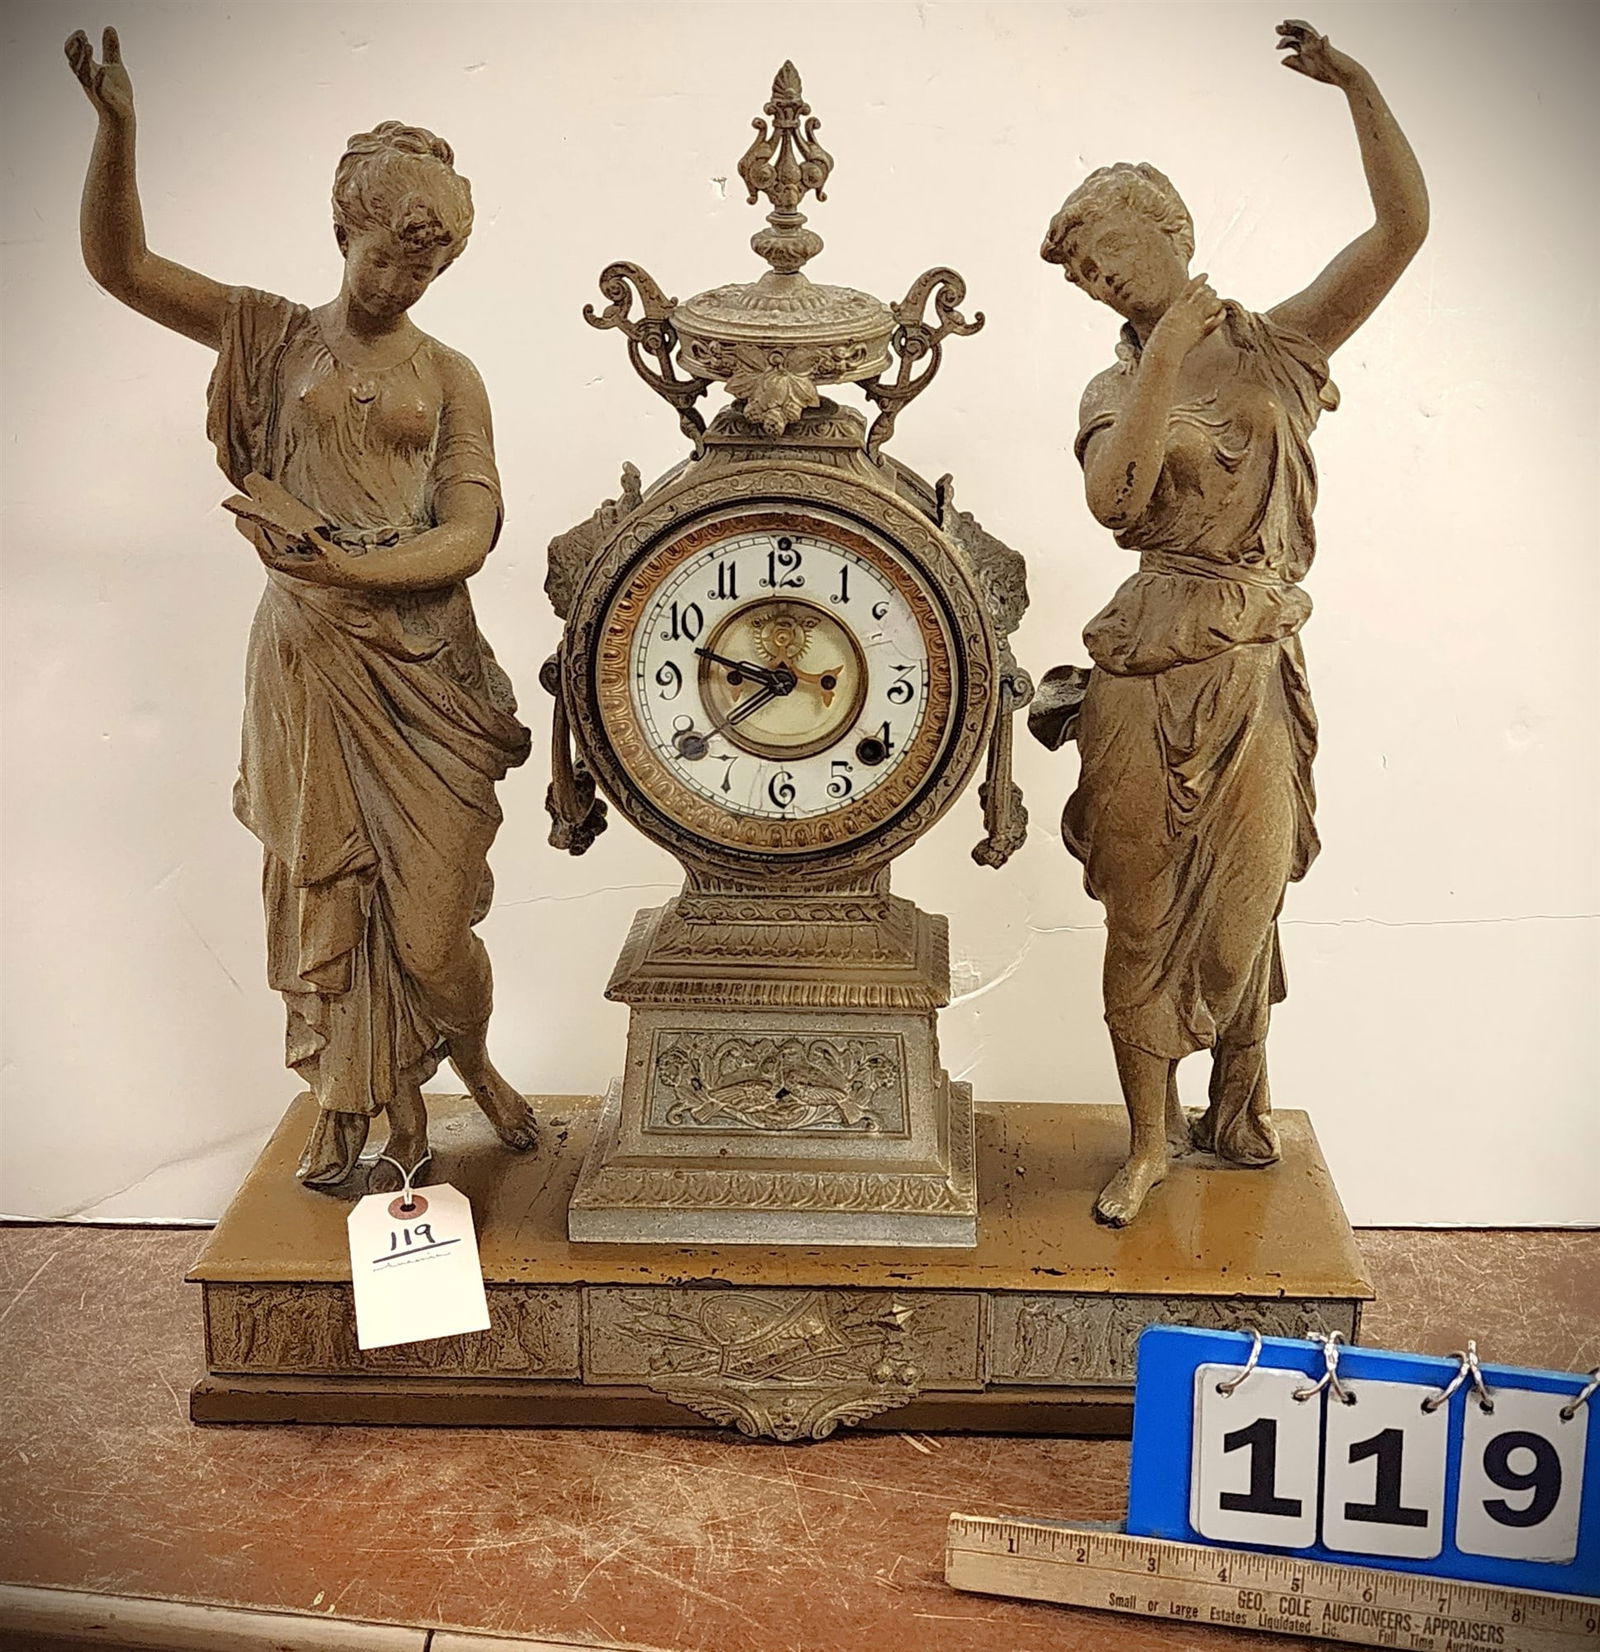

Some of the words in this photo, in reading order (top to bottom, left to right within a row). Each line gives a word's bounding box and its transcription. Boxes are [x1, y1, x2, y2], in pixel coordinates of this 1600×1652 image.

[707, 561, 740, 601] 11
[759, 549, 805, 588] 12
[830, 564, 850, 604] 1
[660, 601, 704, 642] 10
[656, 660, 683, 700] 9
[887, 665, 916, 705] 3
[709, 754, 740, 793] 7
[768, 771, 796, 809] 6
[826, 761, 853, 799] 5
[390, 1223, 435, 1251] 119
[1007, 1538, 1015, 1553] 1
[1076, 1547, 1086, 1563] 2
[1147, 1558, 1156, 1573] 3
[1217, 1568, 1227, 1582] 4
[1291, 1578, 1300, 1593] 5
[1362, 1588, 1373, 1603] 6
[1437, 1598, 1447, 1613] 7
[1511, 1608, 1521, 1623] 8
[1586, 1618, 1596, 1634] 9
[1238, 1590, 1266, 1612] GEO.
[1279, 1596, 1312, 1618] COLE
[1109, 1592, 1137, 1609] Small
[1147, 1600, 1159, 1612] or
[1170, 1601, 1199, 1619] Large
[1210, 1606, 1247, 1625] Estates
[1258, 1613, 1311, 1633] Liquidated
[1410, 1633, 1434, 1649] Time
